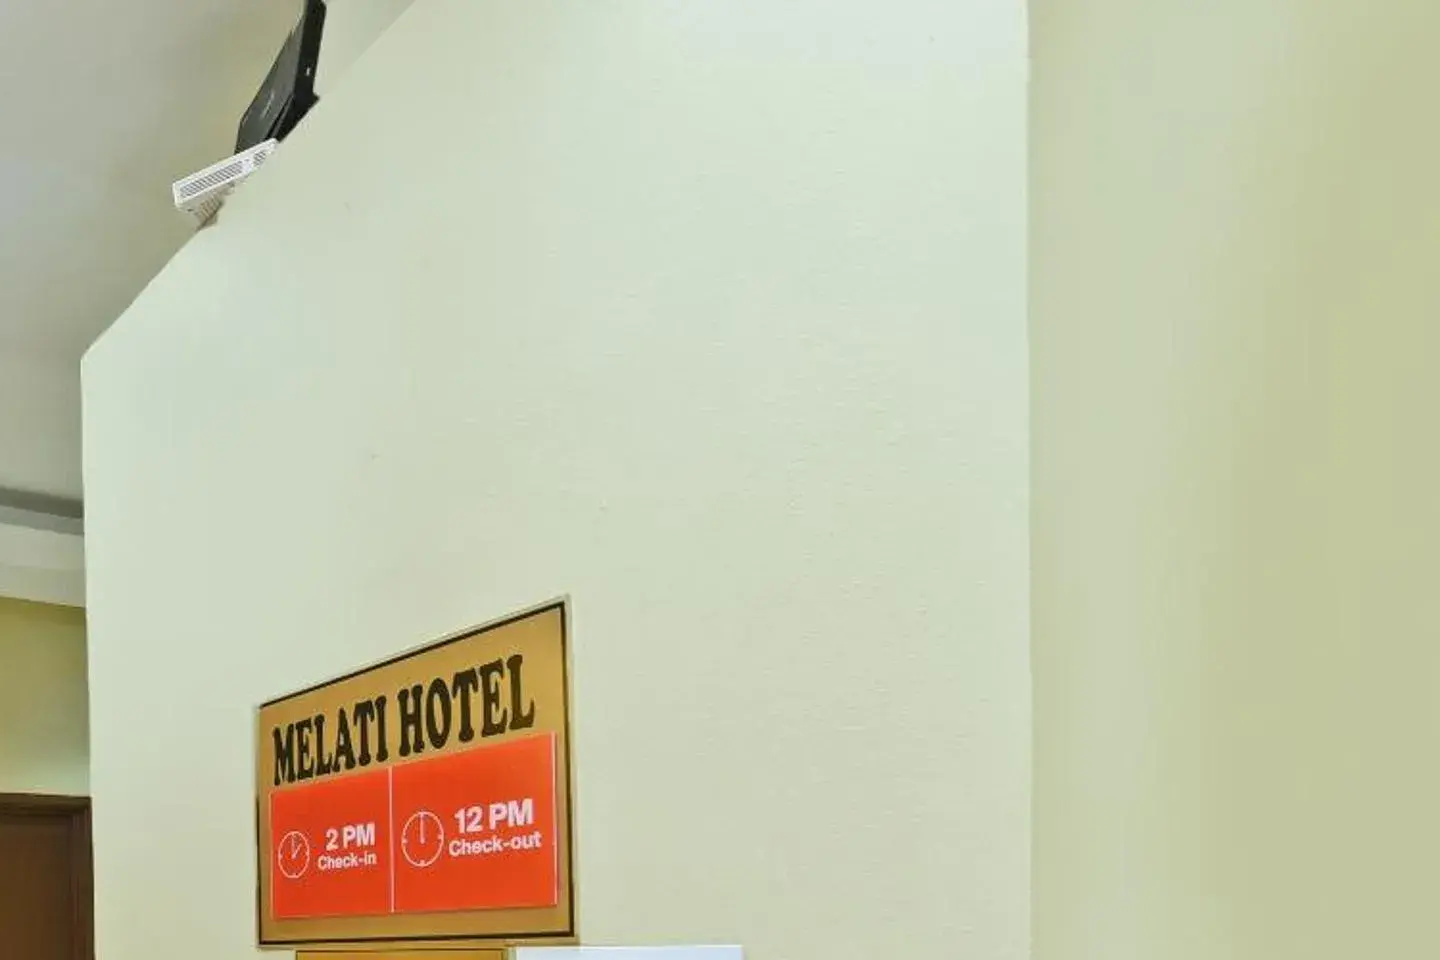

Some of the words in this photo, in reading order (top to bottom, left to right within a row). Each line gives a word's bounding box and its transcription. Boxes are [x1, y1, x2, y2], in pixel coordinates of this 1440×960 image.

[272, 695, 389, 786] MELATI
[397, 654, 535, 757] HOTEL
[455, 806, 482, 834] 12
[489, 798, 534, 829] PM
[325, 828, 339, 851] 2
[343, 822, 376, 848] PM
[448, 831, 542, 857] Check-out
[317, 852, 377, 871] Check-in
